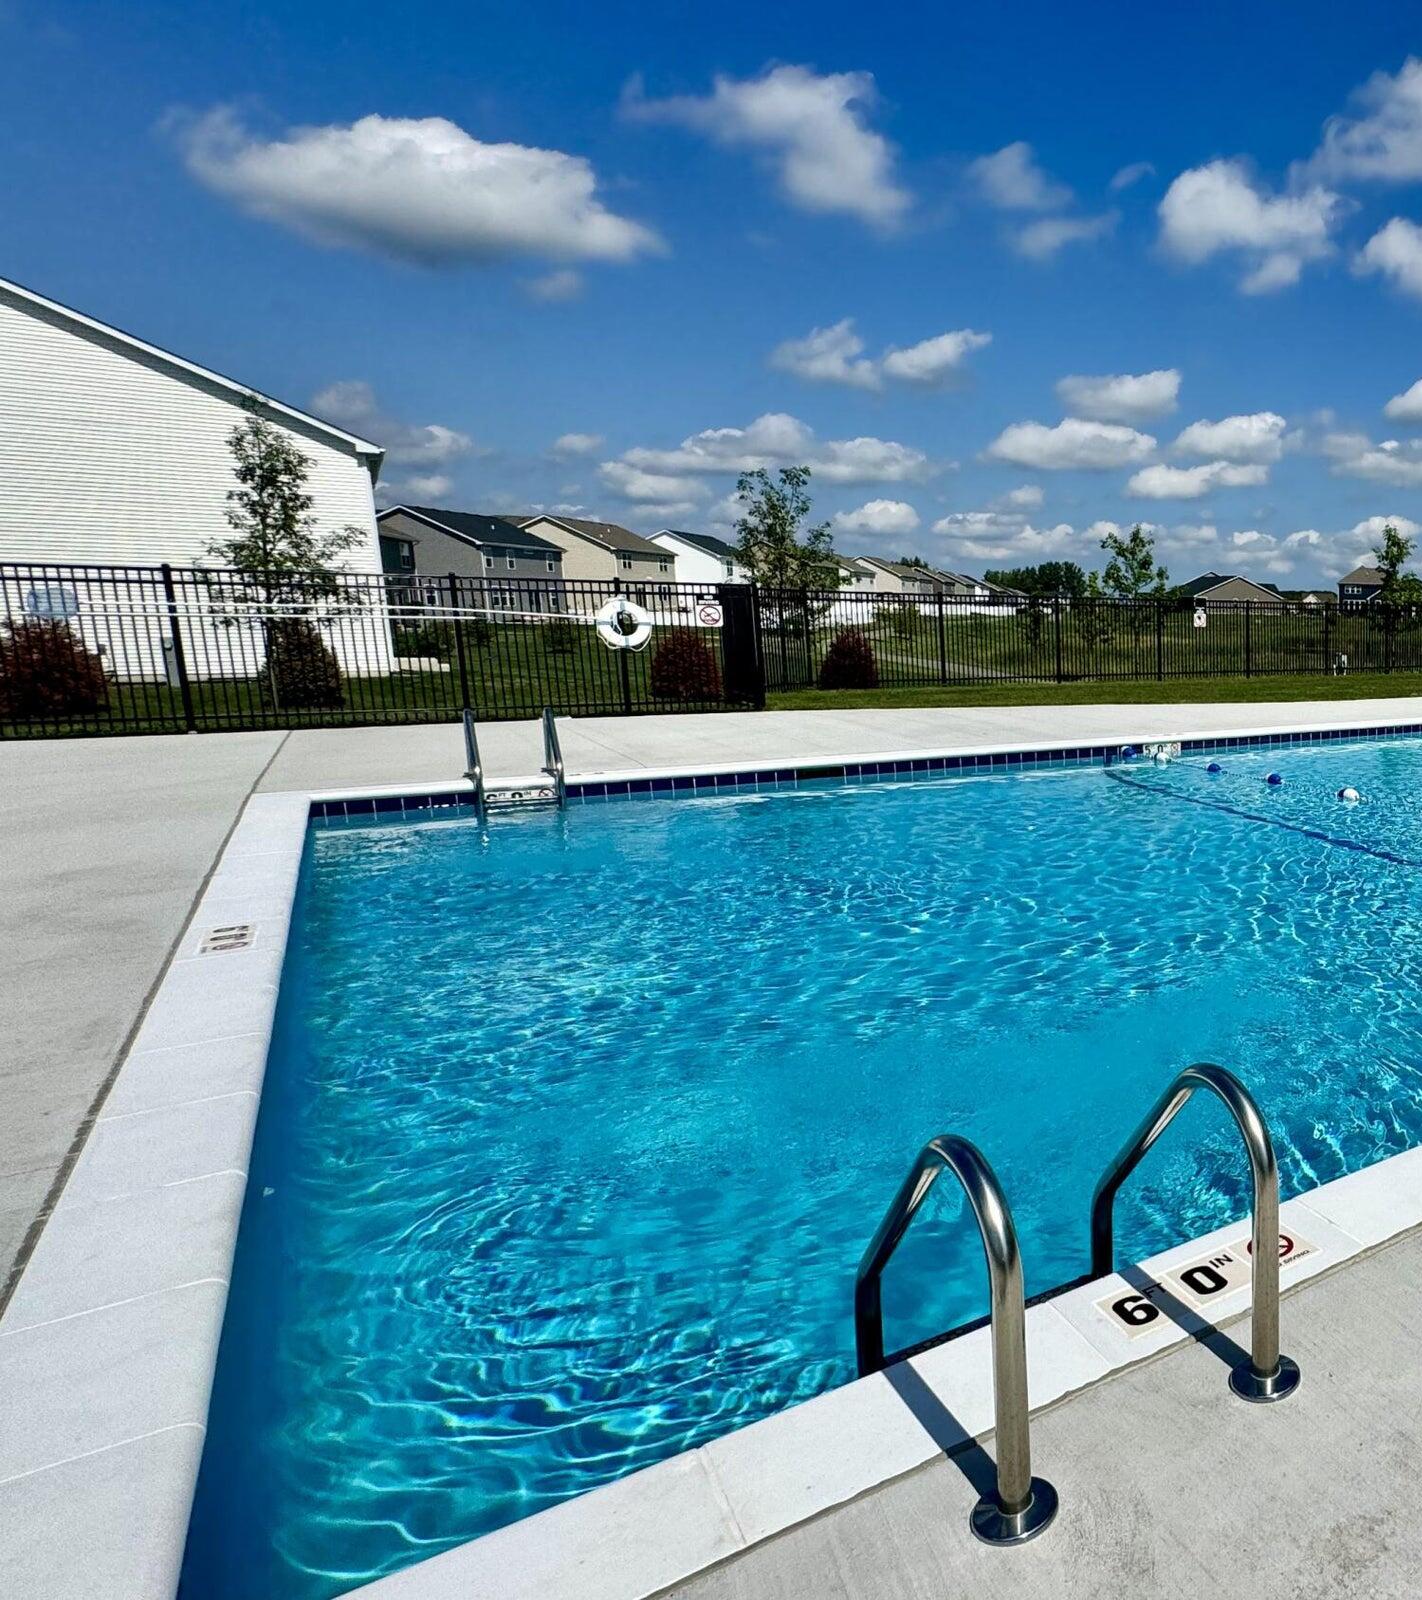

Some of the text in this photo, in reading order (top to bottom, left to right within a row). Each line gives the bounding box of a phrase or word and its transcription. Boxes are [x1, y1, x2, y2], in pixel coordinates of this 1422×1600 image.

[1112, 1254, 1234, 1326] 6 FT 0 IN
